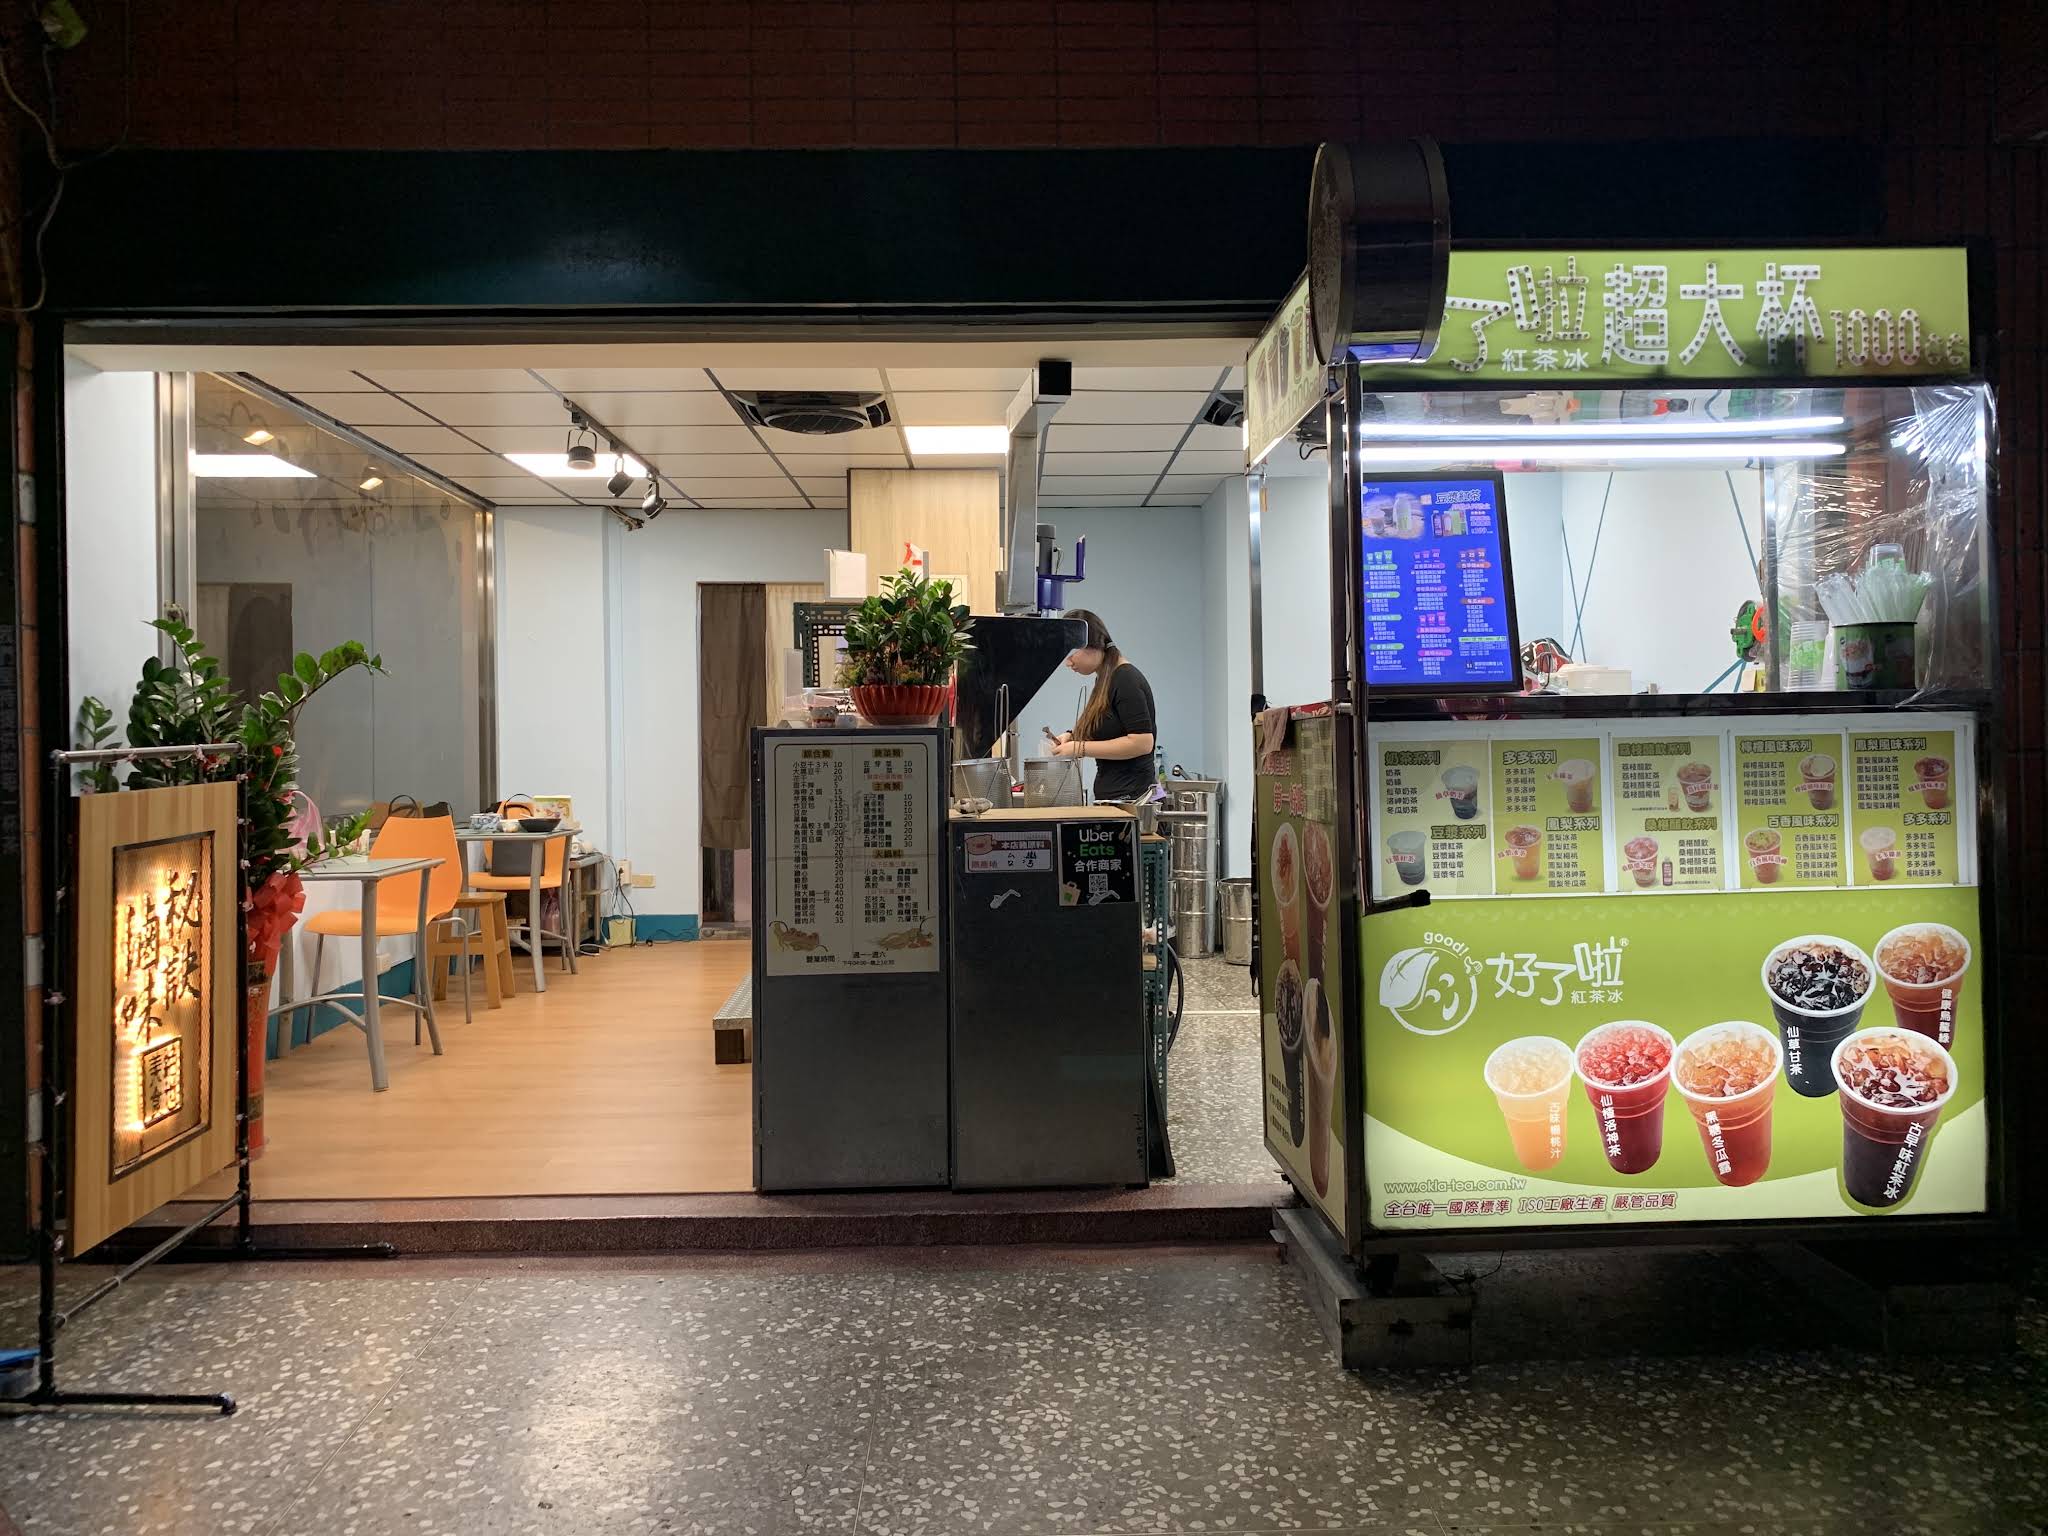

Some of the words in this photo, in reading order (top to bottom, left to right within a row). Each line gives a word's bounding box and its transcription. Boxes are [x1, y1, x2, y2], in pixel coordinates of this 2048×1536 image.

[1501, 347, 1590, 372] 紅茶冰
[1079, 829, 1114, 842] Uber
[1080, 844, 1115, 857] Eats
[1074, 859, 1122, 872] 合作商家
[1423, 931, 1470, 956] good!
[1485, 936, 1624, 1006] 好了啦
[1571, 990, 1624, 1005] 紅茶冰
[1786, 1026, 1802, 1075] 仙草甘茶
[1883, 1121, 1925, 1199] 古早味紅茶冰
[1385, 1199, 1511, 1217] 全台唯一國際標準
[1519, 1195, 1606, 1212] ISO工廠生產
[1613, 1193, 1676, 1209] 嚴管品質
